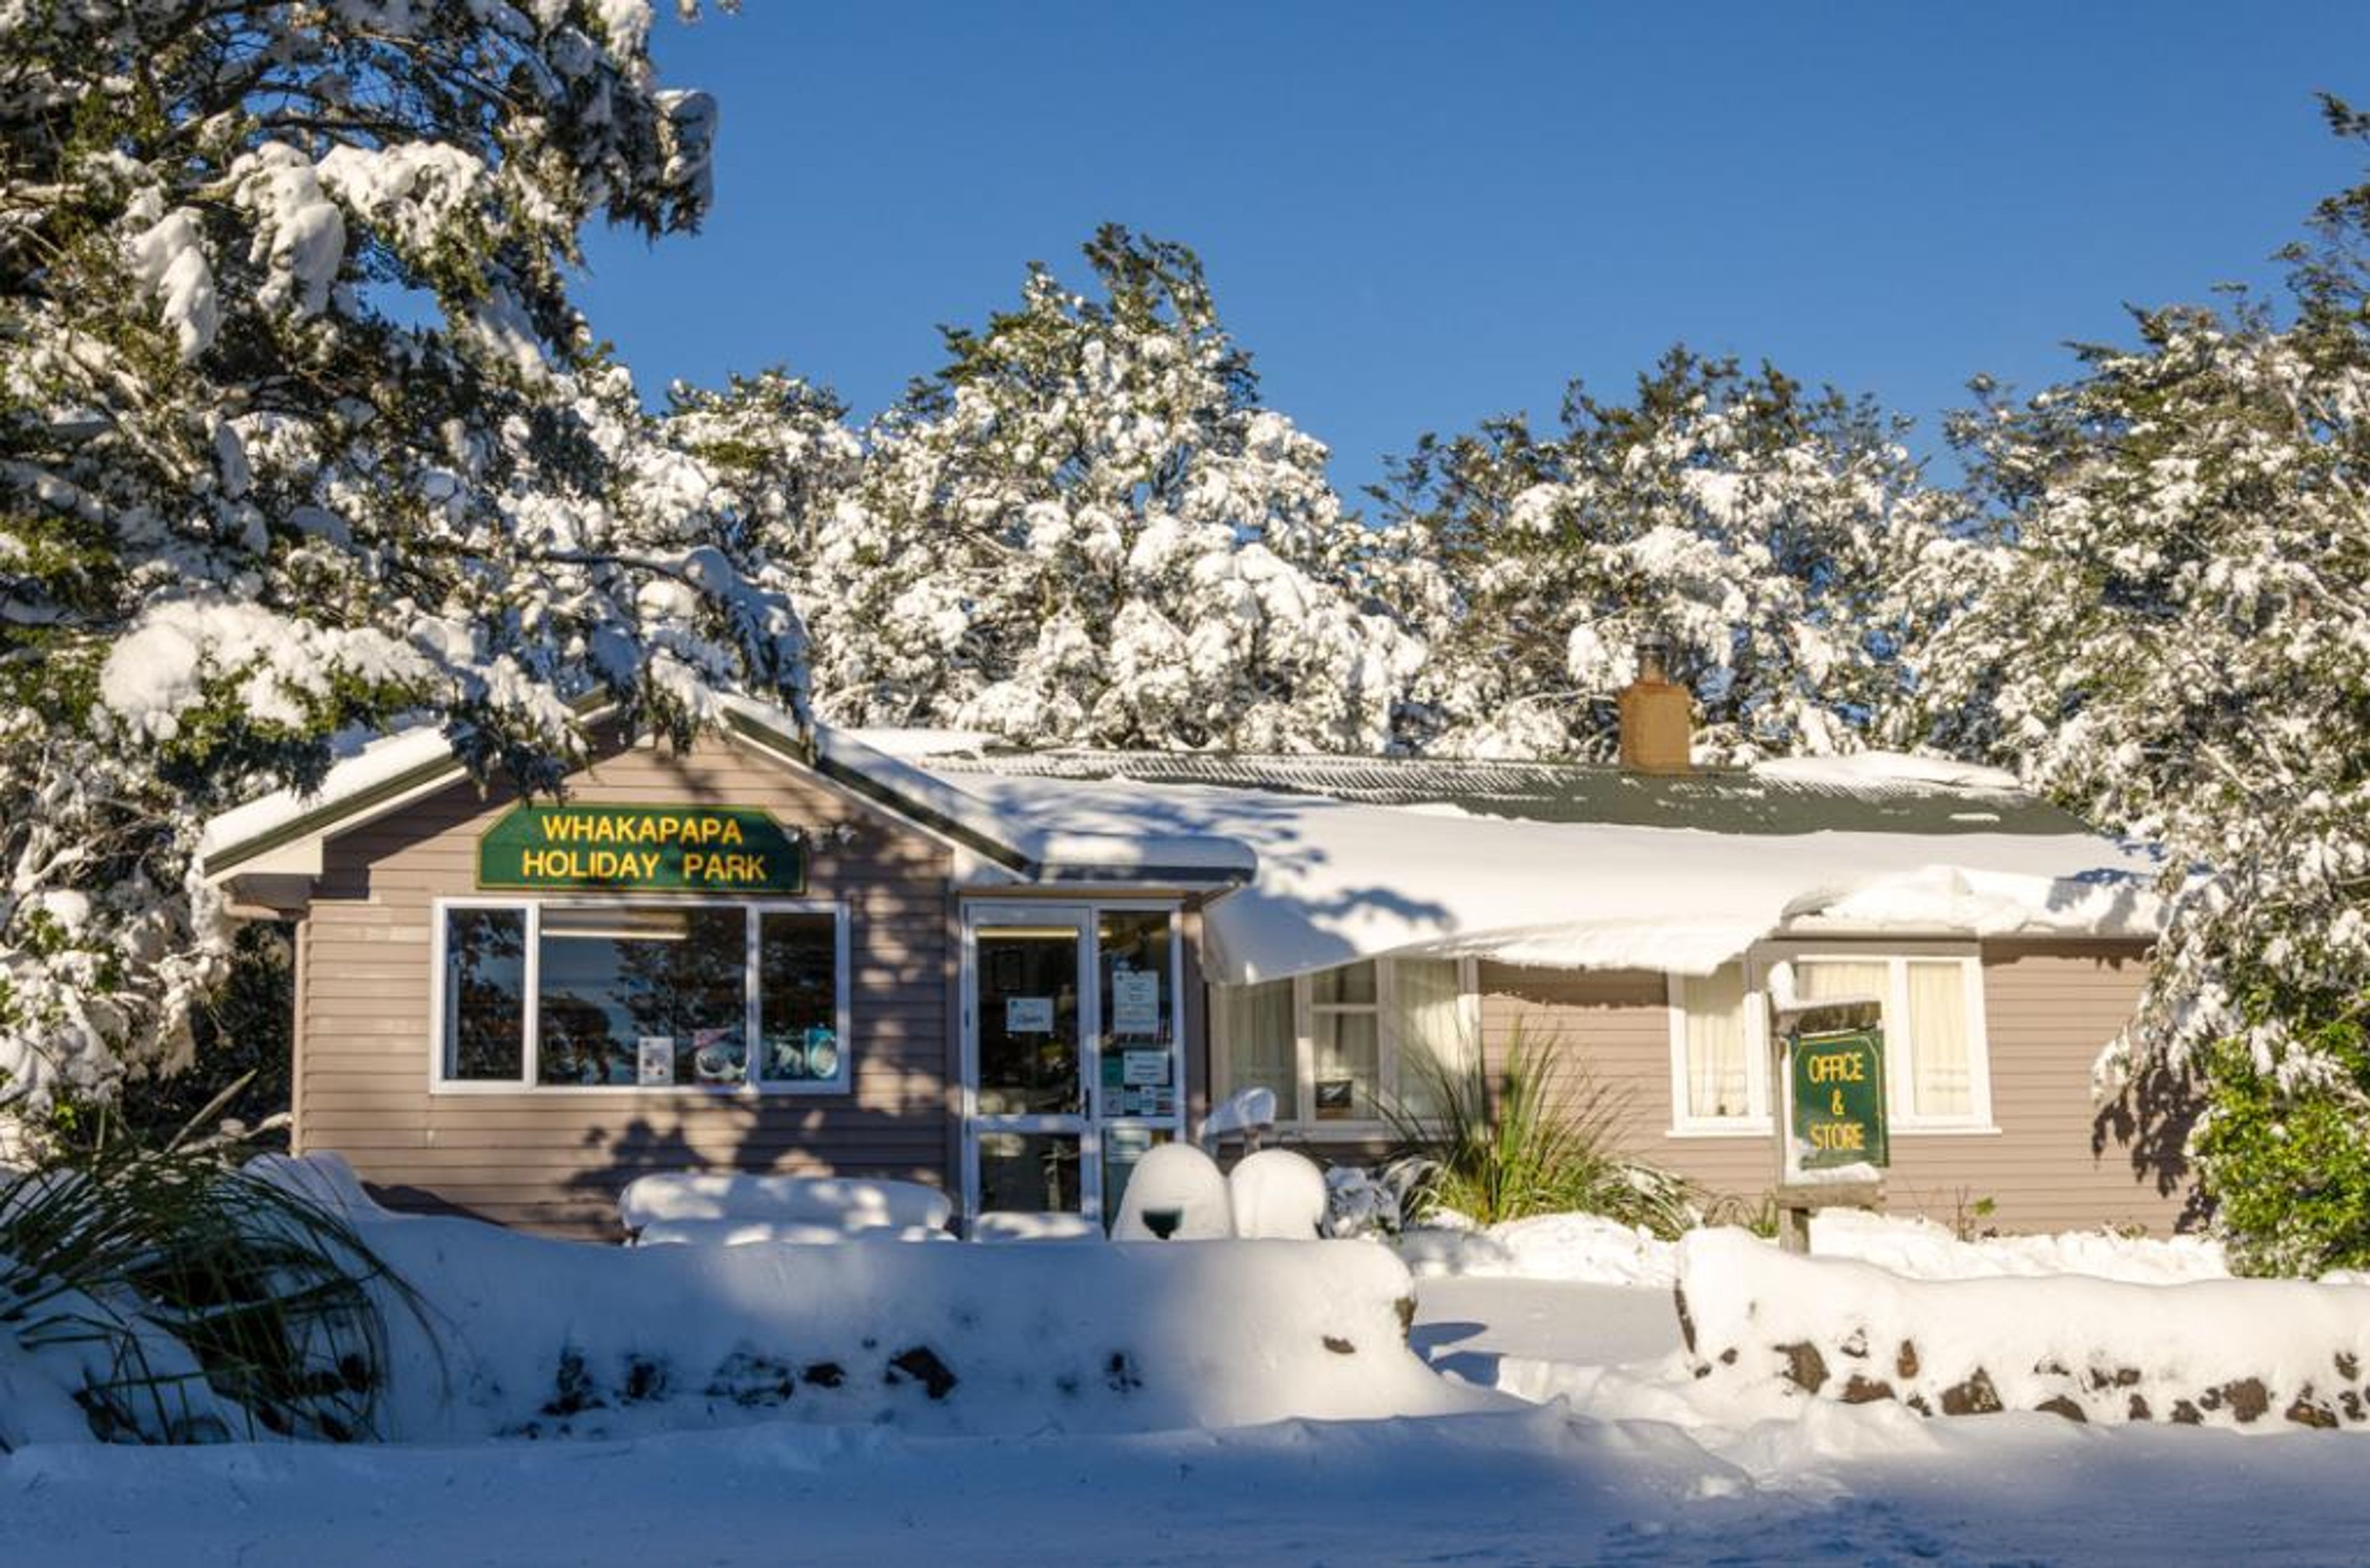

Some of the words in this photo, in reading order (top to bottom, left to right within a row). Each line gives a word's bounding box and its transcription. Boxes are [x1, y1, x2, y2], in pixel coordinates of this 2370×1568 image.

[542, 815, 742, 844] WHAKAPAPA
[523, 850, 660, 879] HOLIDAY
[684, 853, 767, 881] PARK
[1809, 1053, 1864, 1083] OFFICE
[1832, 1088, 1845, 1116] &
[1810, 1122, 1865, 1150] STORE
